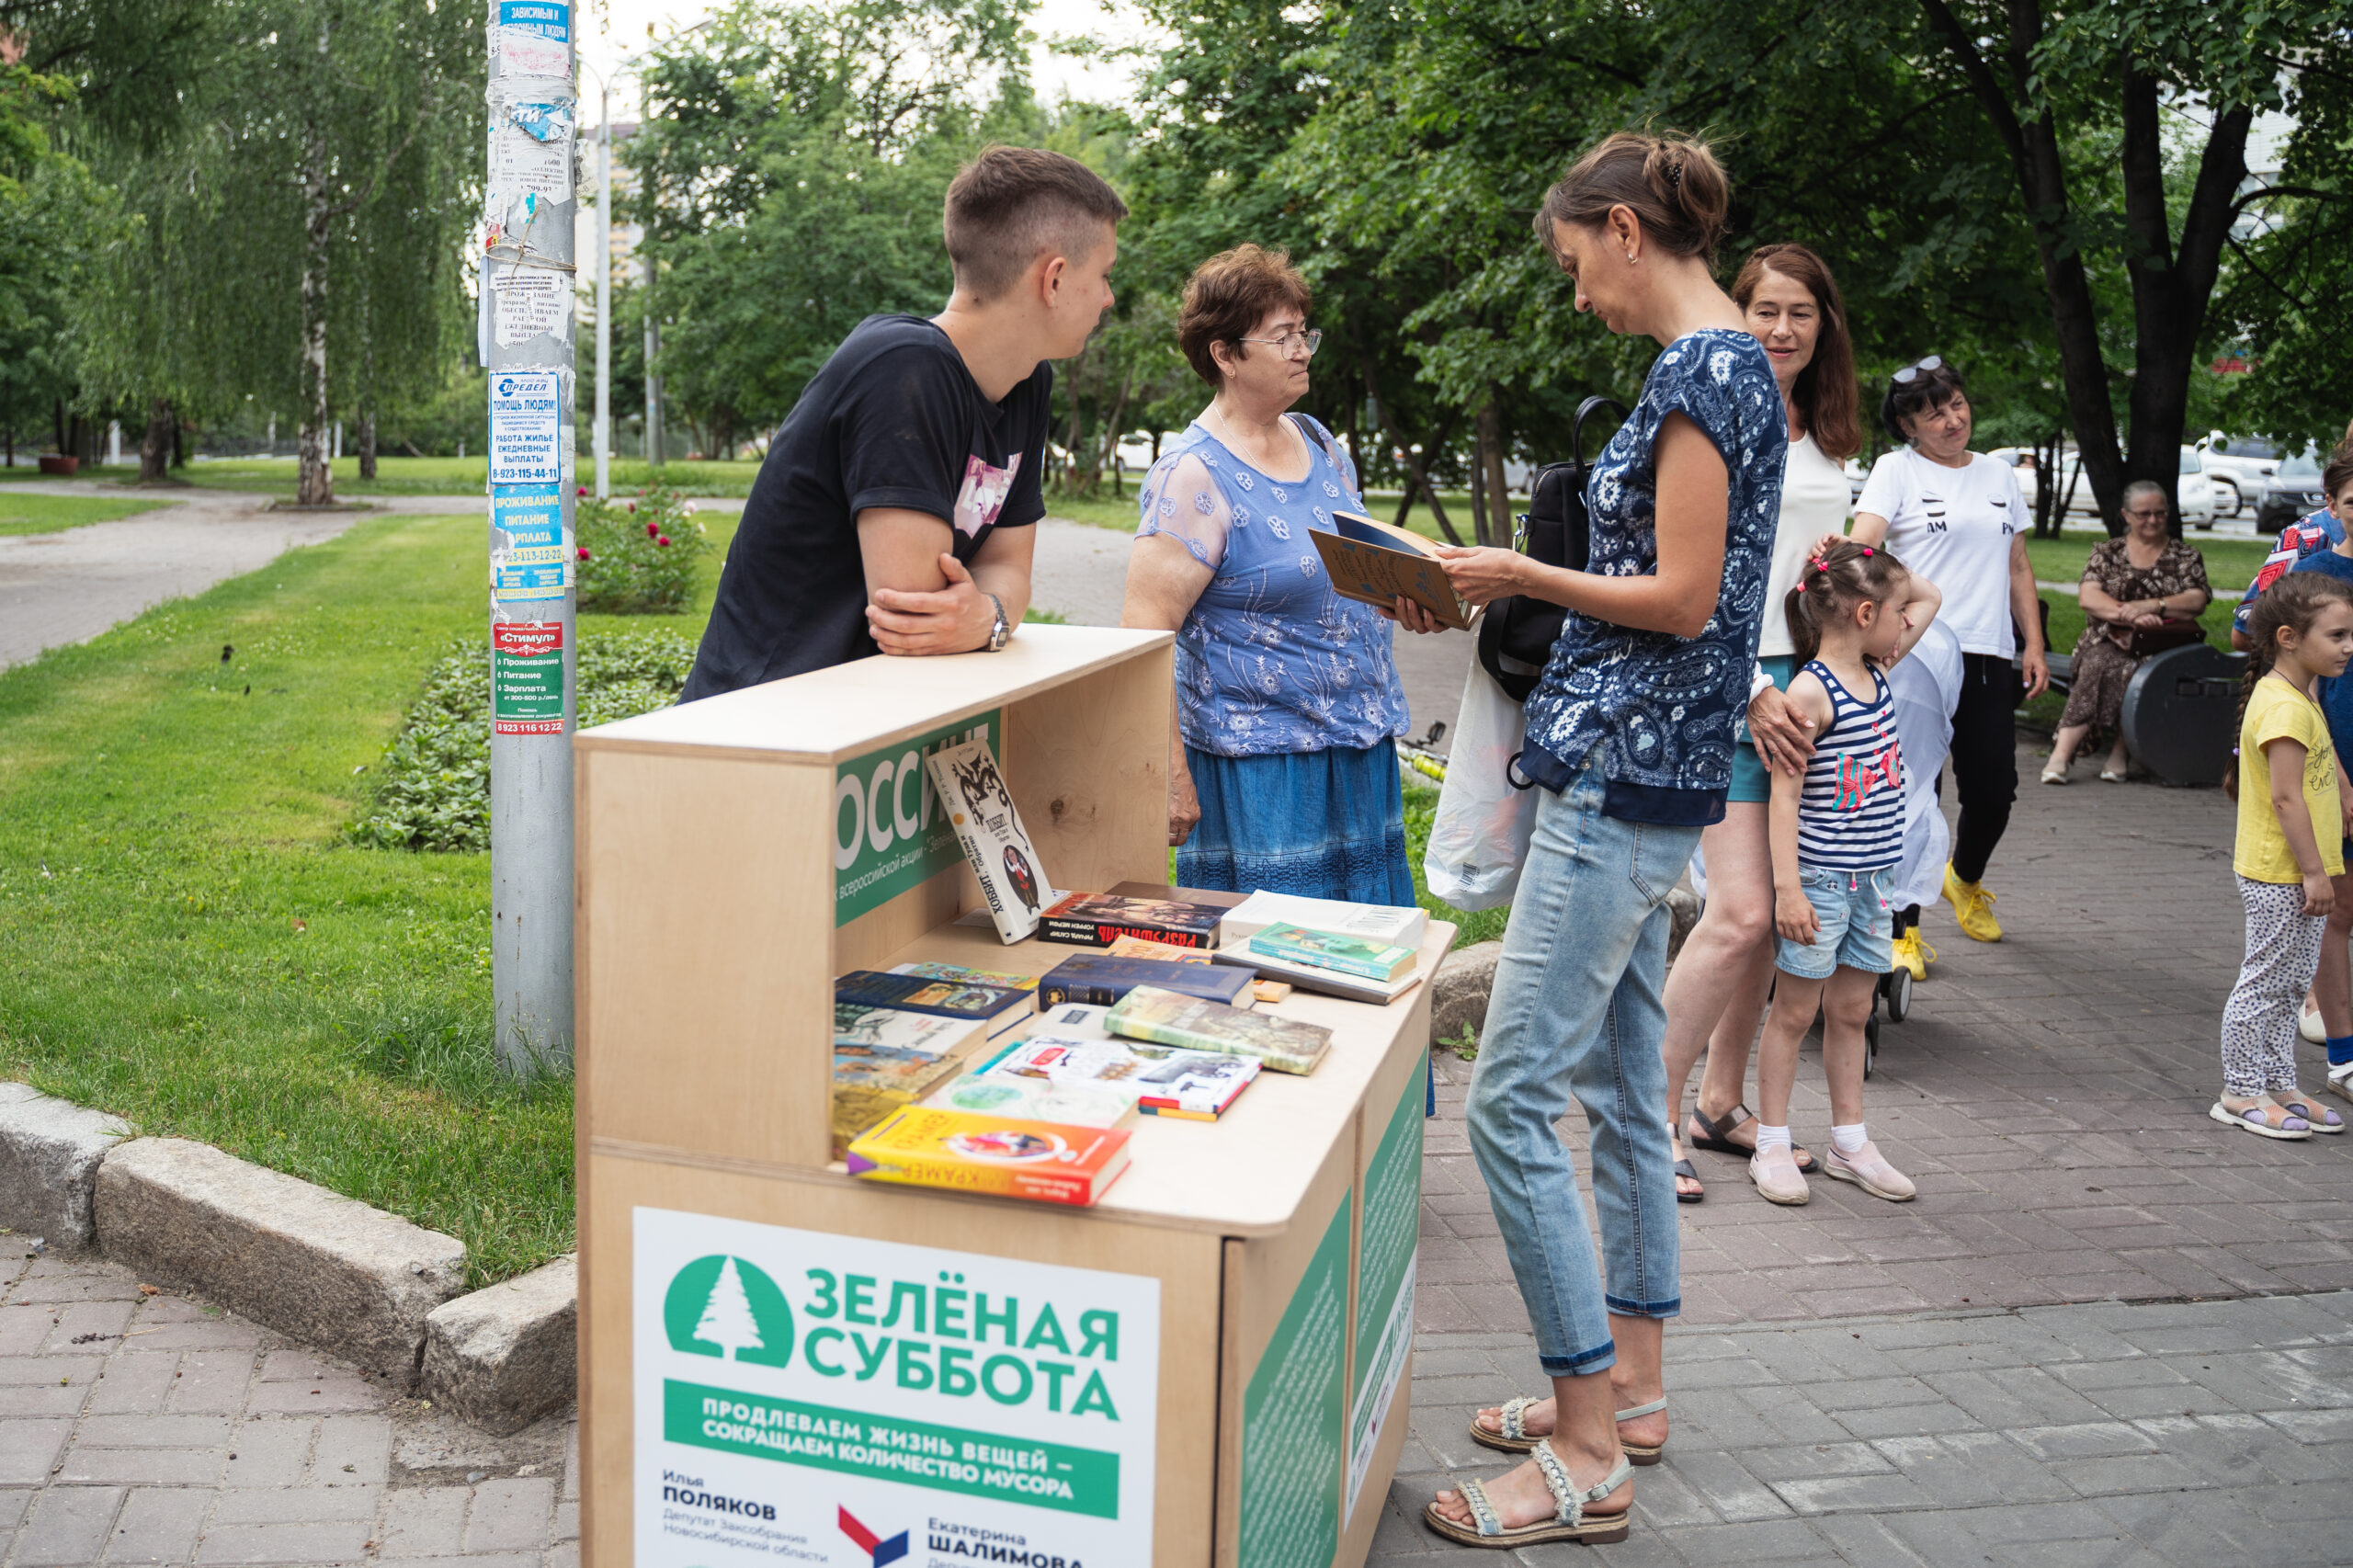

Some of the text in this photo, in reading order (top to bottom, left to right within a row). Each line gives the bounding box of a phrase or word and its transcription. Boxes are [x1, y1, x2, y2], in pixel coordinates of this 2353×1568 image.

[511, 6, 559, 20] ЗАВИСИМЫМ И
[504, 23, 566, 38] ДОМНЫМ ЛЮДЯМ
[494, 400, 556, 413] ПОМОЩЬ ЛЮДЯМ!
[498, 445, 551, 453] ЕЖЕДНЕВНЫЕ
[493, 468, 557, 479] 8-923-115-44-11
[495, 495, 559, 508] ПРОЖИВАНИЕ
[506, 515, 550, 527] ПИТАНИЕ
[1927, 521, 1947, 533] AM
[514, 532, 551, 543] РПЛАТА
[500, 633, 555, 644] «Стимул»
[503, 658, 559, 666] Проживание
[504, 671, 541, 679] Питание
[504, 685, 546, 693] Зарплата
[839, 853, 900, 900] всероссийской
[900, 846, 924, 868] акции
[802, 1268, 1119, 1361] ЗЕЛЁНАЯ
[802, 1326, 1120, 1422] СУББОТА
[702, 1397, 861, 1442] ПРОДЛЕВАЕМ
[869, 1427, 953, 1456] ЖИЗНЬ
[961, 1440, 1049, 1472] ВЕЩЕЙ
[702, 1418, 1074, 1500] СОКРАЩАЕМ КОЛИЧЕСТВО МУСОРА
[663, 1470, 704, 1487] Илья
[663, 1486, 777, 1521] ПОЛЯКОВ
[663, 1507, 808, 1544] Депутат Заксобрания
[928, 1517, 1027, 1547] Екатерина
[663, 1522, 829, 1563] Новосибирской области
[927, 1534, 1084, 1568] ШАЛИМОВА
